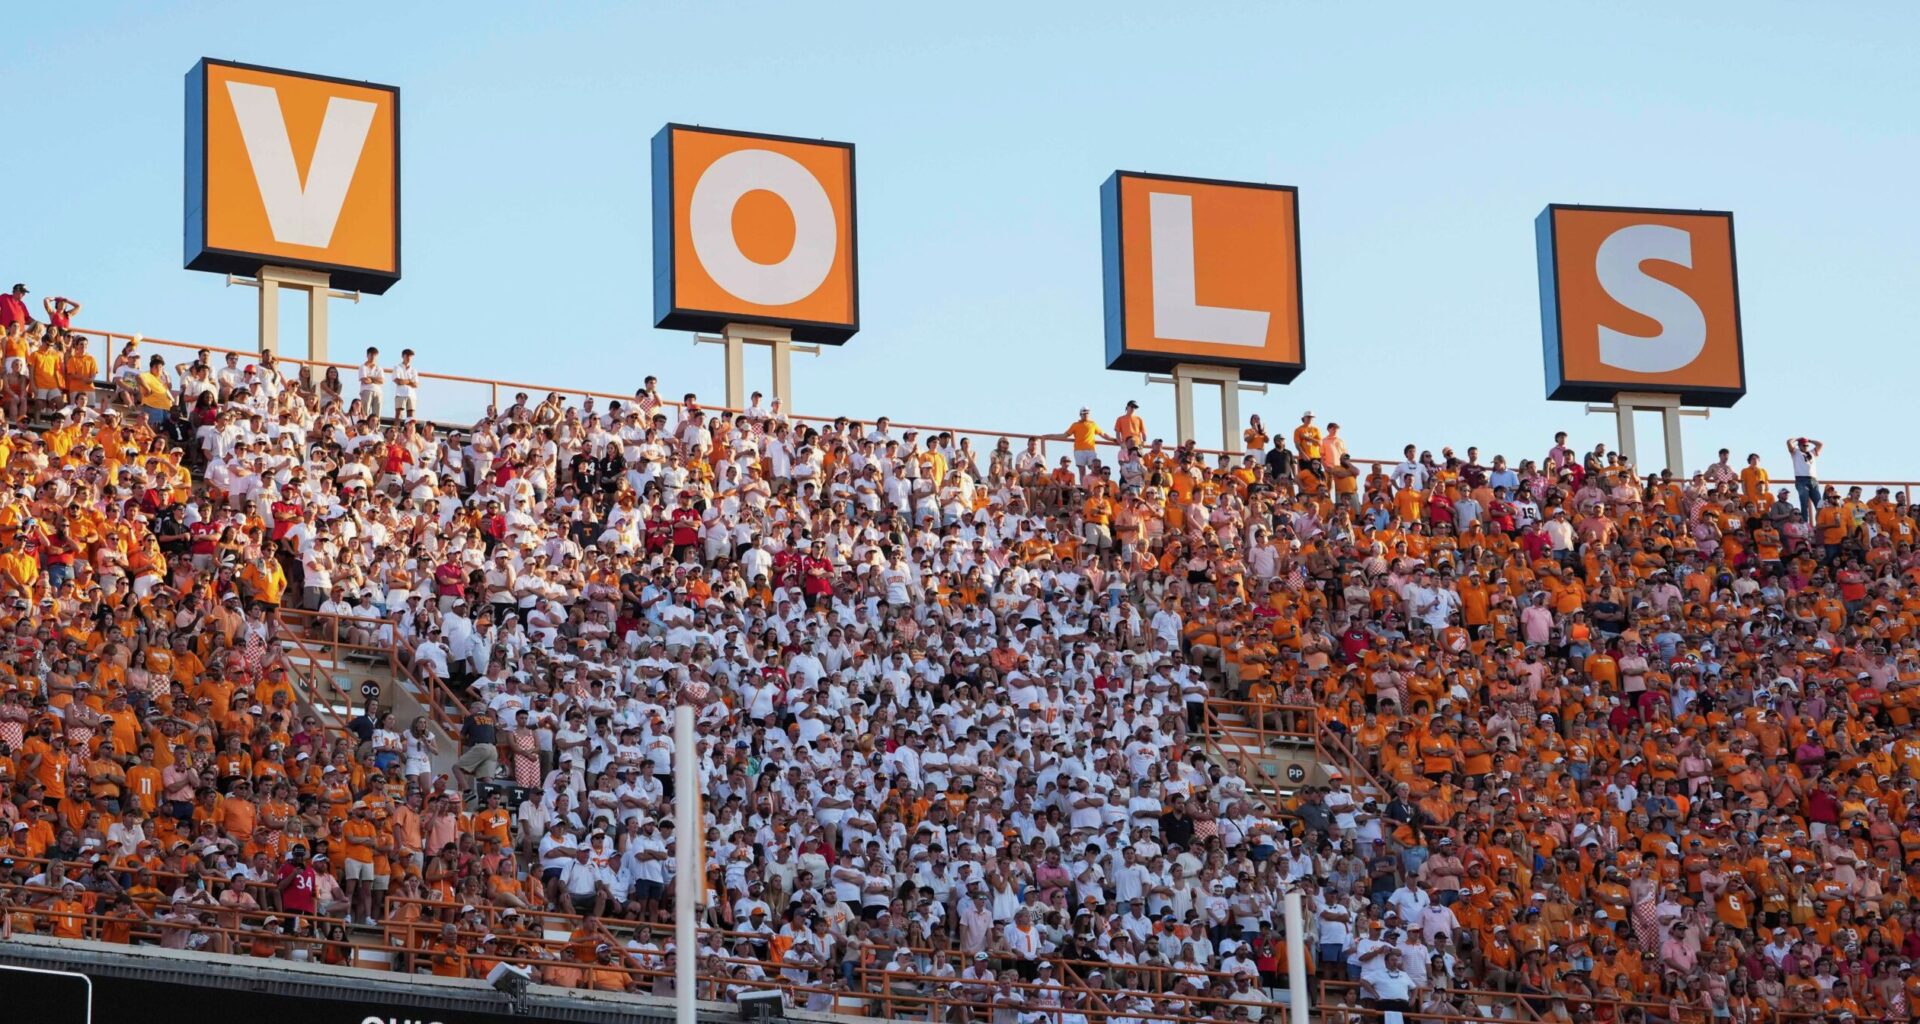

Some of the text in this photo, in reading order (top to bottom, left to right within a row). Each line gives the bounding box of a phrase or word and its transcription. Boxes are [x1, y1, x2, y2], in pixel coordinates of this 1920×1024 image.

[225, 81, 378, 249] V
[690, 149, 837, 305] O
[1150, 192, 1270, 348] L
[1595, 225, 1707, 372] S
[1757, 500, 1766, 511] T
[1522, 507, 1535, 519] 19
[583, 528, 593, 537] T
[24, 680, 34, 690] T
[361, 685, 379, 696] OO
[1289, 768, 1303, 779] PP
[141, 777, 151, 795] 11
[514, 790, 524, 799] T
[1496, 855, 1506, 865] T
[296, 875, 312, 891] 34
[1728, 895, 1741, 911] 6
